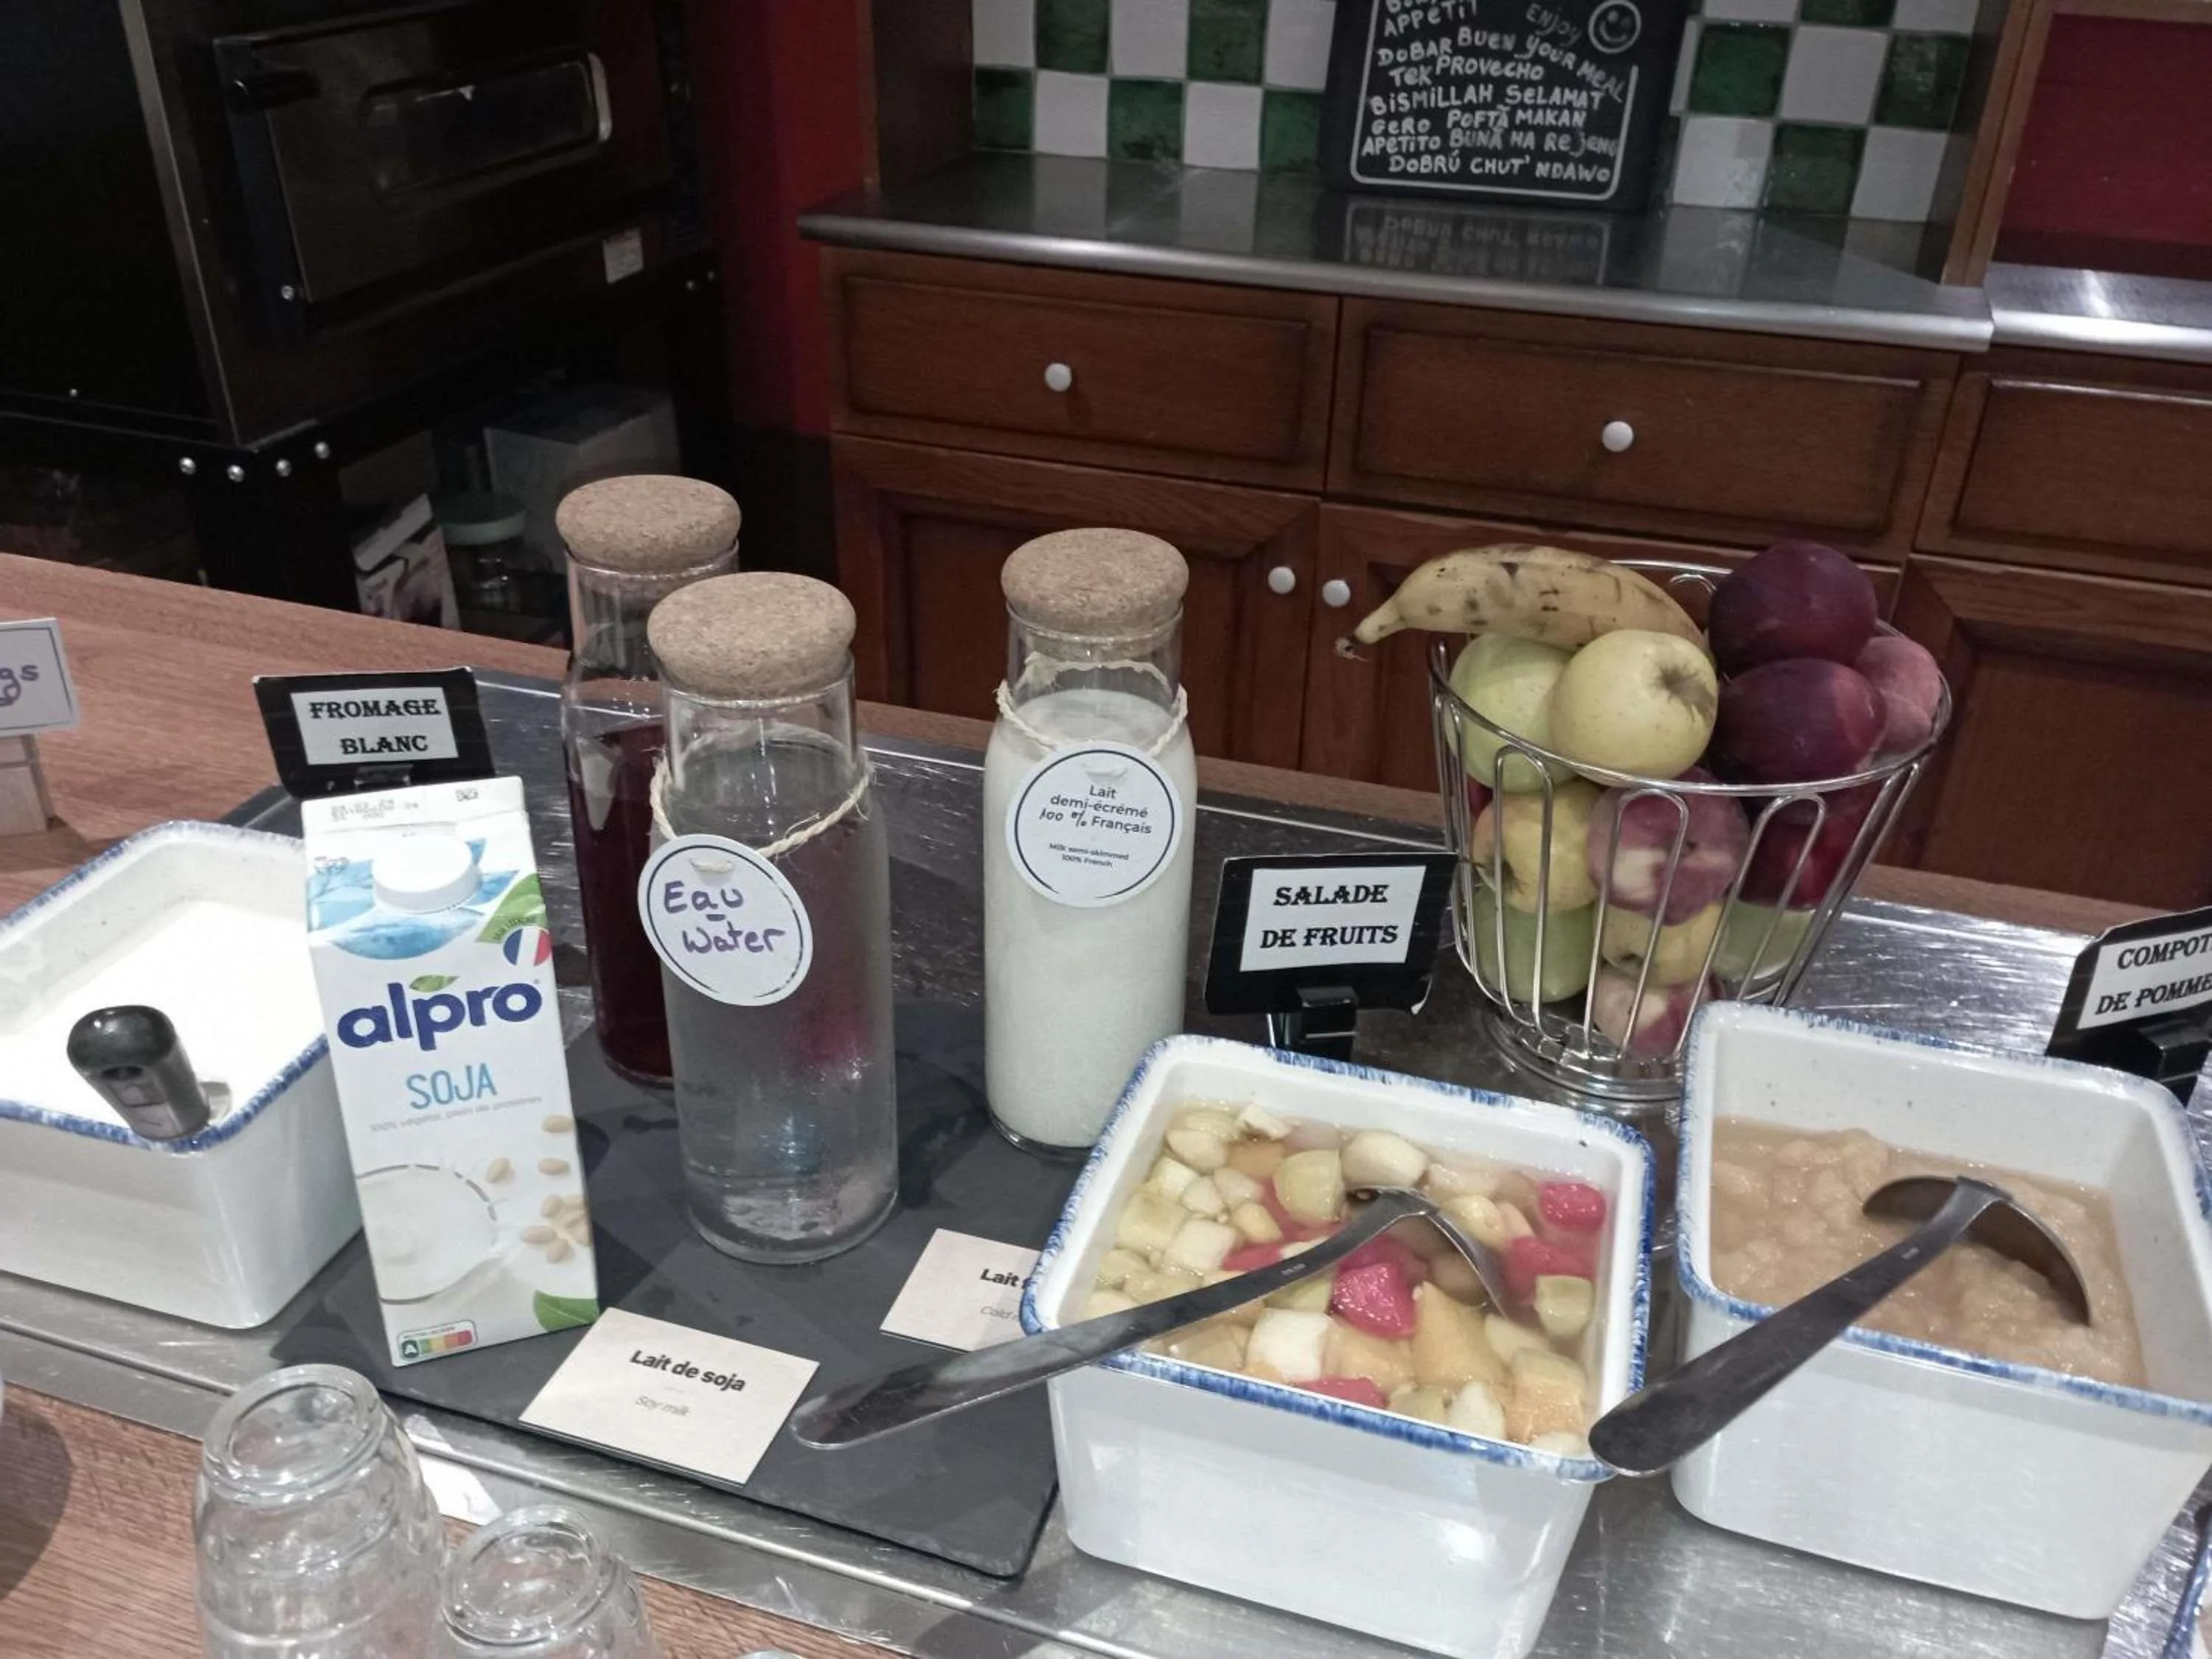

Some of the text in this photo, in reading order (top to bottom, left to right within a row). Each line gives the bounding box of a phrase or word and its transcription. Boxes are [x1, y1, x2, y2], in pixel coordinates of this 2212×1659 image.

[1515, 108, 1587, 128] MAKAN
[310, 699, 442, 719] FROMAGE
[340, 735, 428, 754] BLANC
[1089, 785, 1116, 799] Lait
[1050, 793, 1149, 818] demi-écrémé
[1091, 815, 1152, 835] Français
[664, 880, 744, 914] Eau
[1273, 884, 1390, 906] SALADE
[1259, 925, 1399, 949] DE FRUITS
[2095, 991, 2132, 1015] DE
[337, 981, 543, 1051] alpro
[406, 1063, 498, 1110] SOJA
[980, 1268, 1020, 1287] Lait
[630, 1350, 746, 1392] Lait de soja
